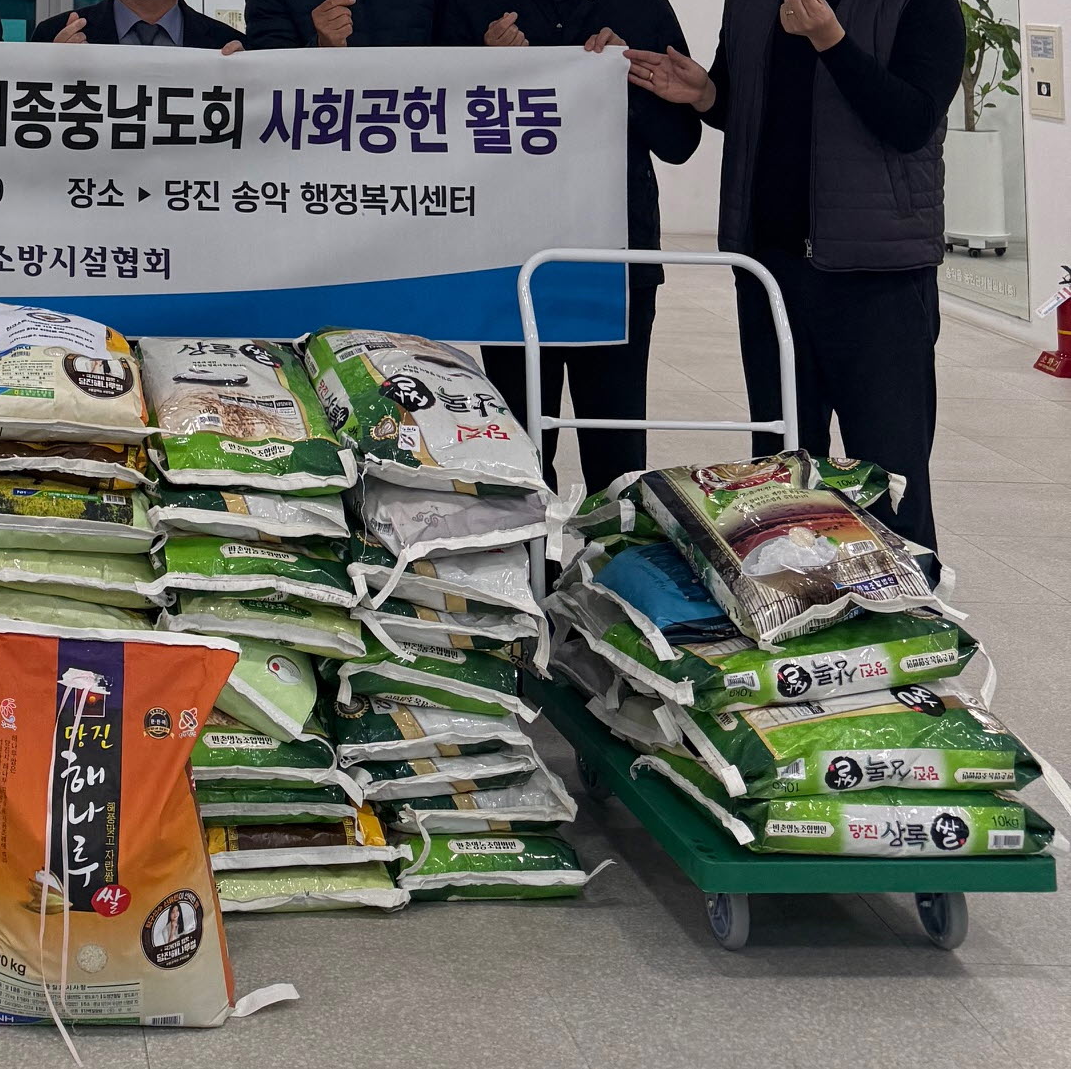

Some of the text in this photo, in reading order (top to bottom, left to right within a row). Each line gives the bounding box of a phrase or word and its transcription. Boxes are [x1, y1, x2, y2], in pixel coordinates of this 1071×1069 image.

[259, 85, 448, 154] 사회공헌
[465, 85, 562, 155] 활동
[67, 177, 477, 217] 장소 당진 송악 행정복지센터
[177, 341, 240, 359] 상록
[457, 423, 511, 443] 당진
[811, 659, 858, 686] 상록
[860, 661, 890, 679] 당진
[64, 723, 114, 748] 당진
[913, 765, 940, 782] 당진
[772, 781, 800, 793] 10kg
[60, 750, 107, 888] 해나루
[847, 822, 878, 840] 당진
[880, 820, 930, 851] 상록
[933, 815, 967, 851] 쌀
[991, 814, 1021, 830] 10kg
[95, 885, 128, 916] 쌀
[10, 958, 27, 976] kg
